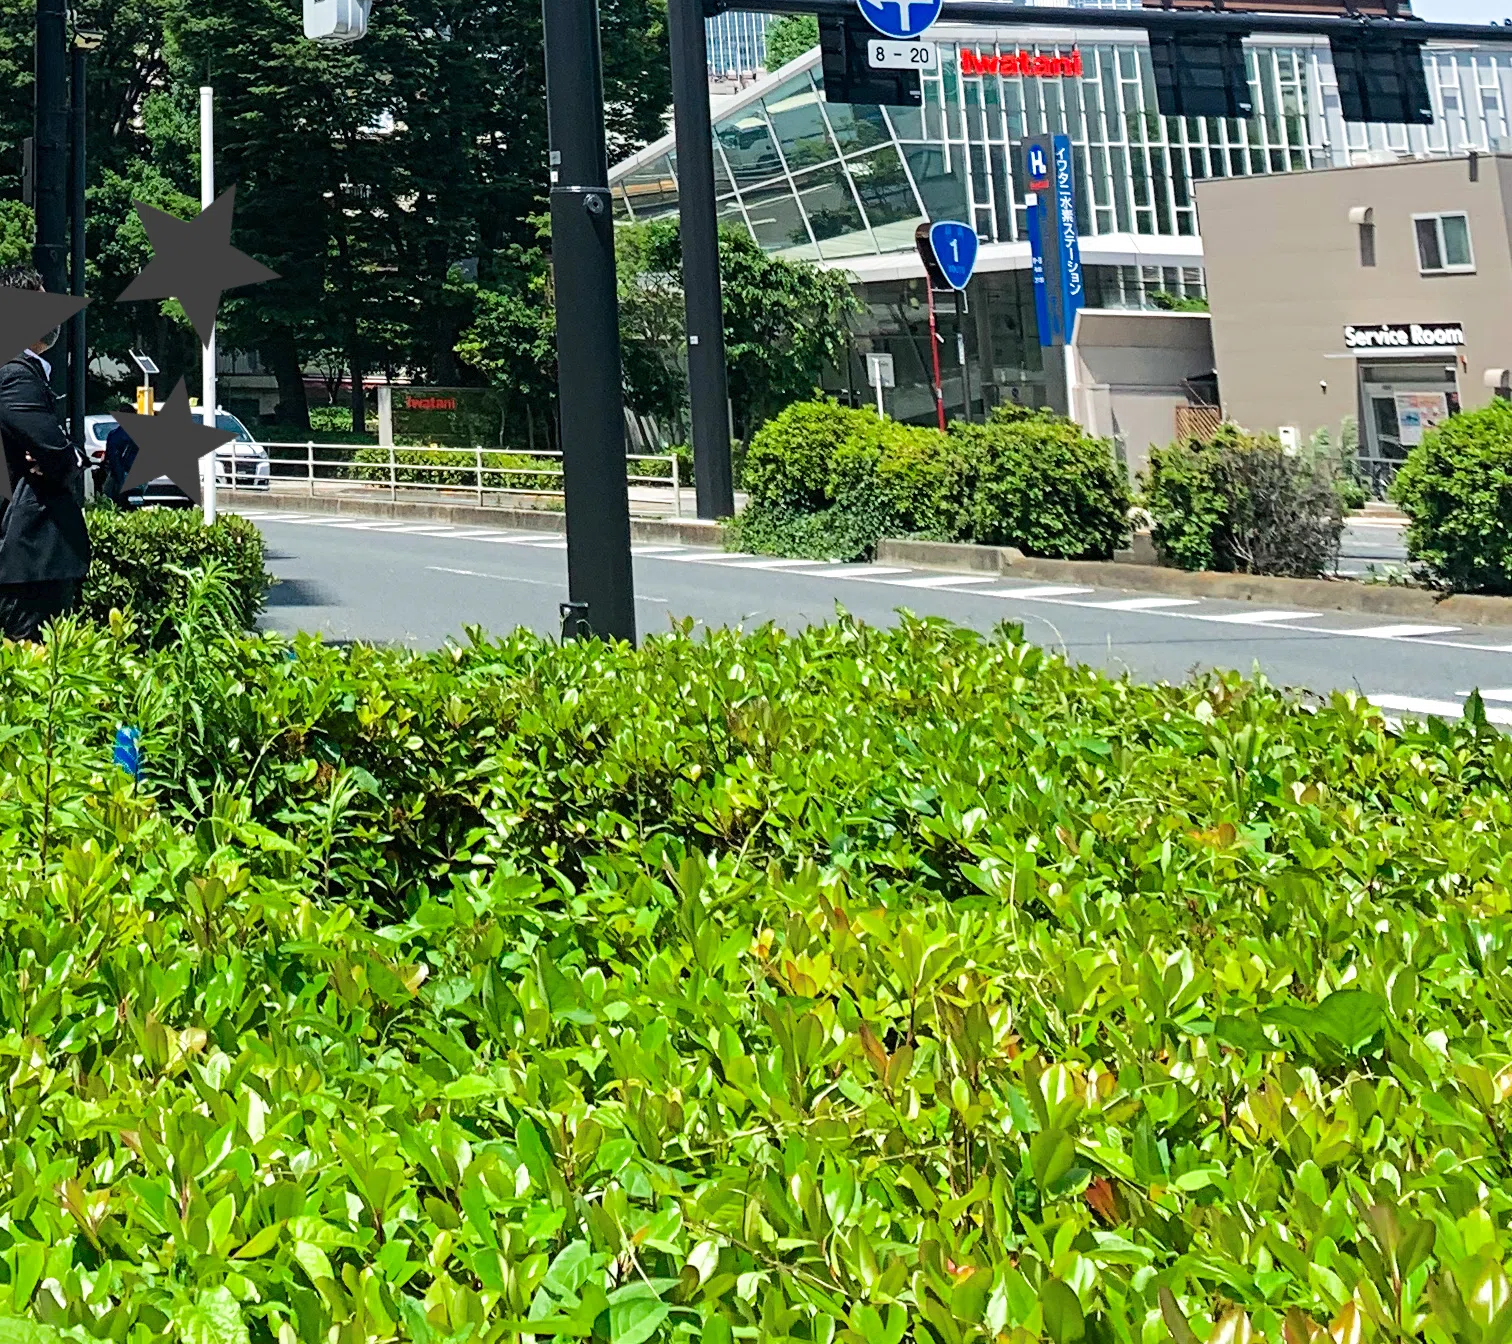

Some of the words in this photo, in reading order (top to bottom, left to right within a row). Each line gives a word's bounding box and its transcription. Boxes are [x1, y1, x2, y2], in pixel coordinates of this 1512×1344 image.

[960, 47, 1084, 77] Iwatani
[1055, 147, 1082, 296] イワタニ水素ステーション
[949, 238, 959, 263] 1
[1345, 325, 1409, 346] Service
[1410, 324, 1464, 345] Room
